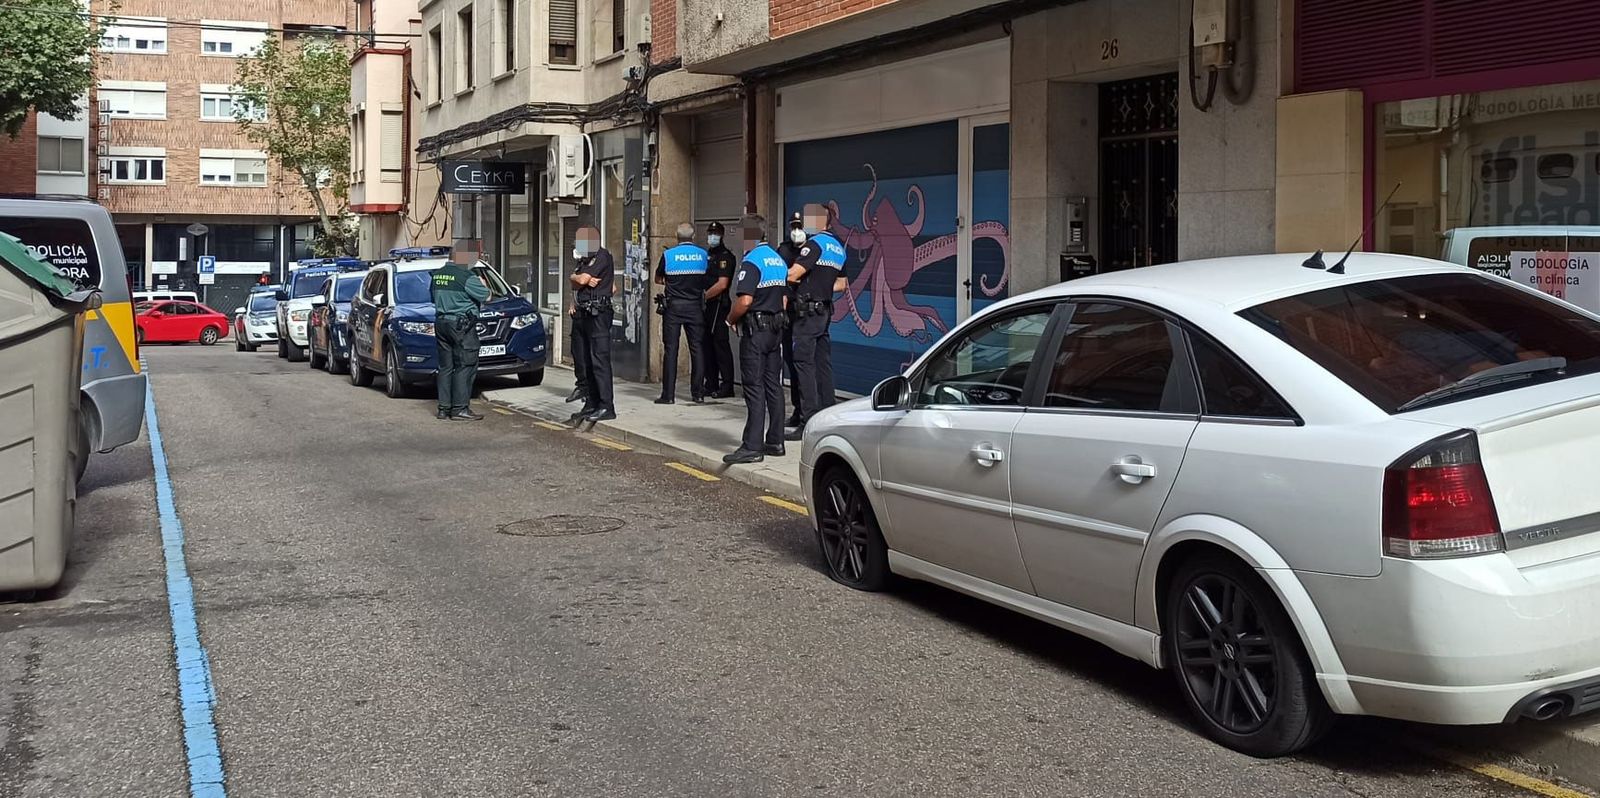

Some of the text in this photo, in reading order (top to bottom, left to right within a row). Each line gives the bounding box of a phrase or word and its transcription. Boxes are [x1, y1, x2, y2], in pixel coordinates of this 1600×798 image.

[1101, 38, 1119, 60] 26
[454, 164, 515, 183] CEYKA
[53, 257, 88, 265] municipal
[202, 258, 212, 271] P
[1520, 256, 1589, 270] PODOLOGÍA
[1529, 273, 1580, 285] en clínica
